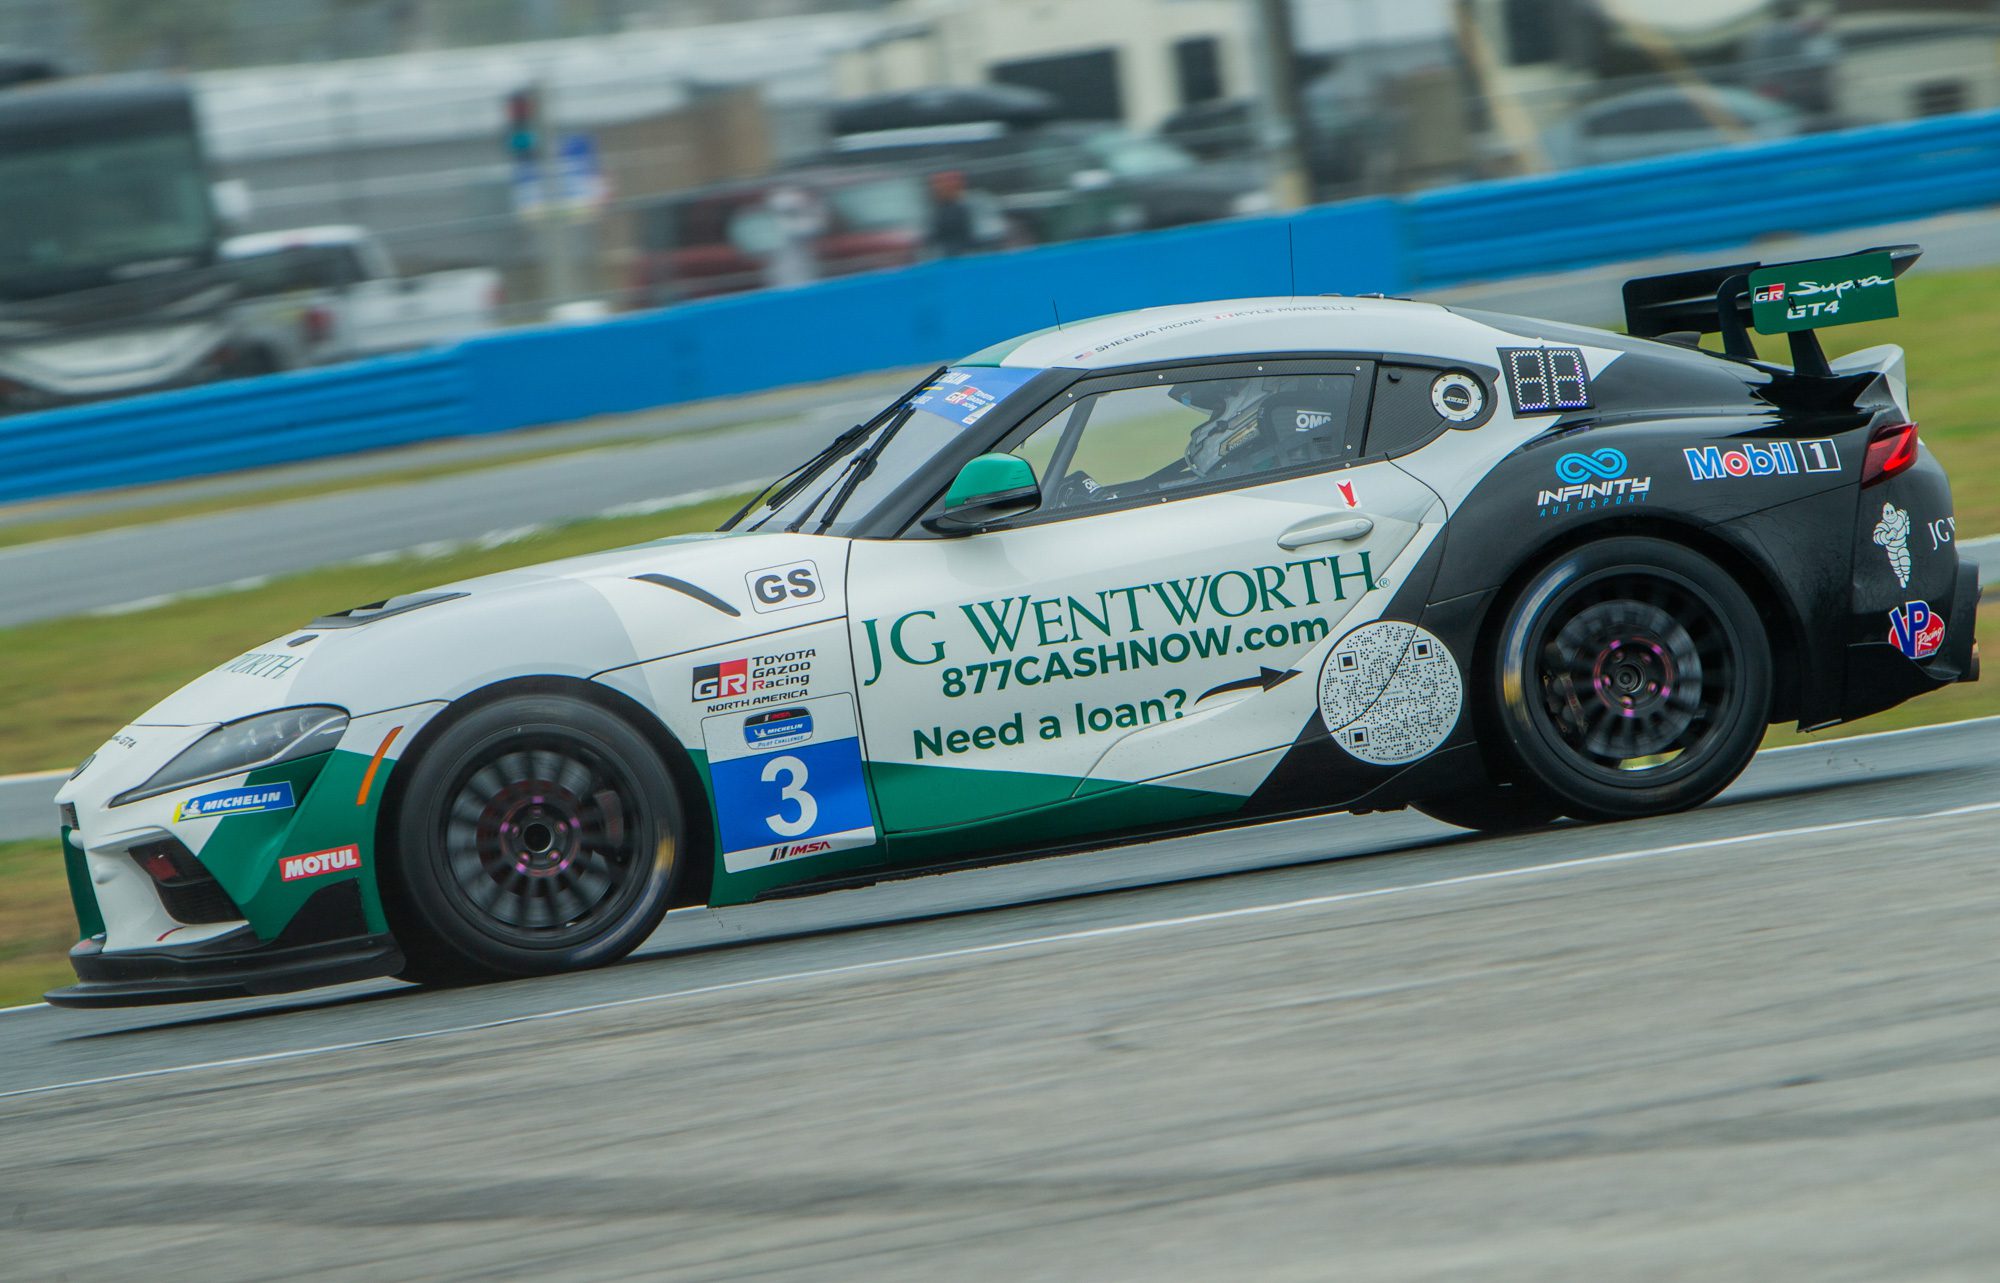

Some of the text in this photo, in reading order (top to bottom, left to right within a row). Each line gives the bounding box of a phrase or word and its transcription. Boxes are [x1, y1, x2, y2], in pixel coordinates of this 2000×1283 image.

[1754, 275, 1895, 302] GR Supra
[1786, 300, 1840, 319] GT4
[1095, 329, 1156, 352] SHEENA
[1158, 318, 1206, 332] MONK
[1683, 442, 1798, 481] Mobil
[1537, 477, 1652, 506] INFINITY
[1539, 493, 1649, 517] AUTOSPORT
[1928, 519, 1950, 550] JG
[755, 568, 817, 604] GS
[861, 551, 1380, 686] JG WENTWORTH
[1889, 600, 1931, 659] VP
[1917, 627, 1943, 650] Racing
[753, 661, 811, 679] GAZOO
[942, 616, 1330, 697] 877CASHNOW.com
[692, 648, 817, 701] GR TOYOTA
[752, 674, 811, 691] Racing
[707, 689, 808, 713] NORTH AMERICA
[767, 723, 804, 735] MICHELIN
[913, 688, 1187, 760] Need a loan?
[202, 791, 282, 811] MICHELIN
[761, 755, 818, 837] 3
[789, 840, 832, 856] IMSA
[285, 849, 358, 879] MOTUL
